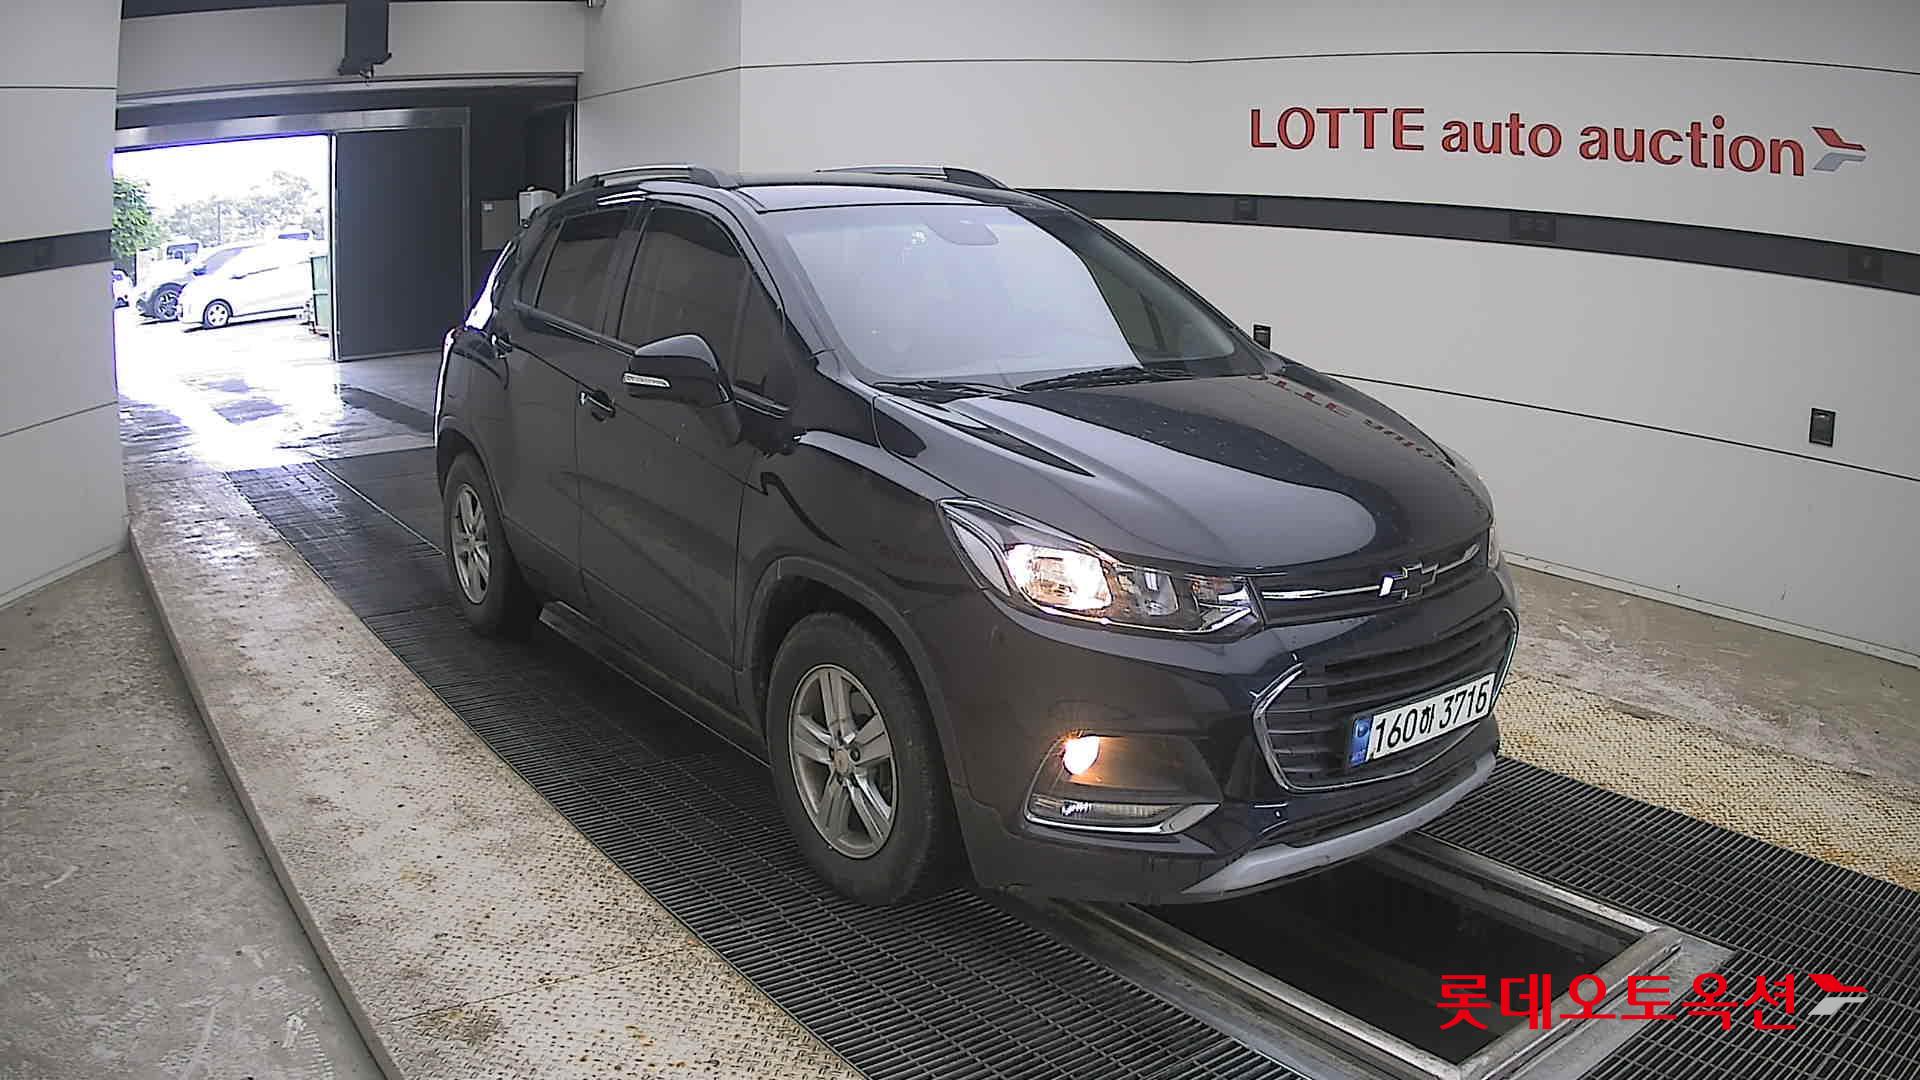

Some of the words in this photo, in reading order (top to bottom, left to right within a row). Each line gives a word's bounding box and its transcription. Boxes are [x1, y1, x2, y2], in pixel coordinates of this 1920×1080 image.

[1251, 108, 1425, 151] LOTTE
[1442, 113, 1563, 156] auto
[1579, 115, 1805, 176] auction
